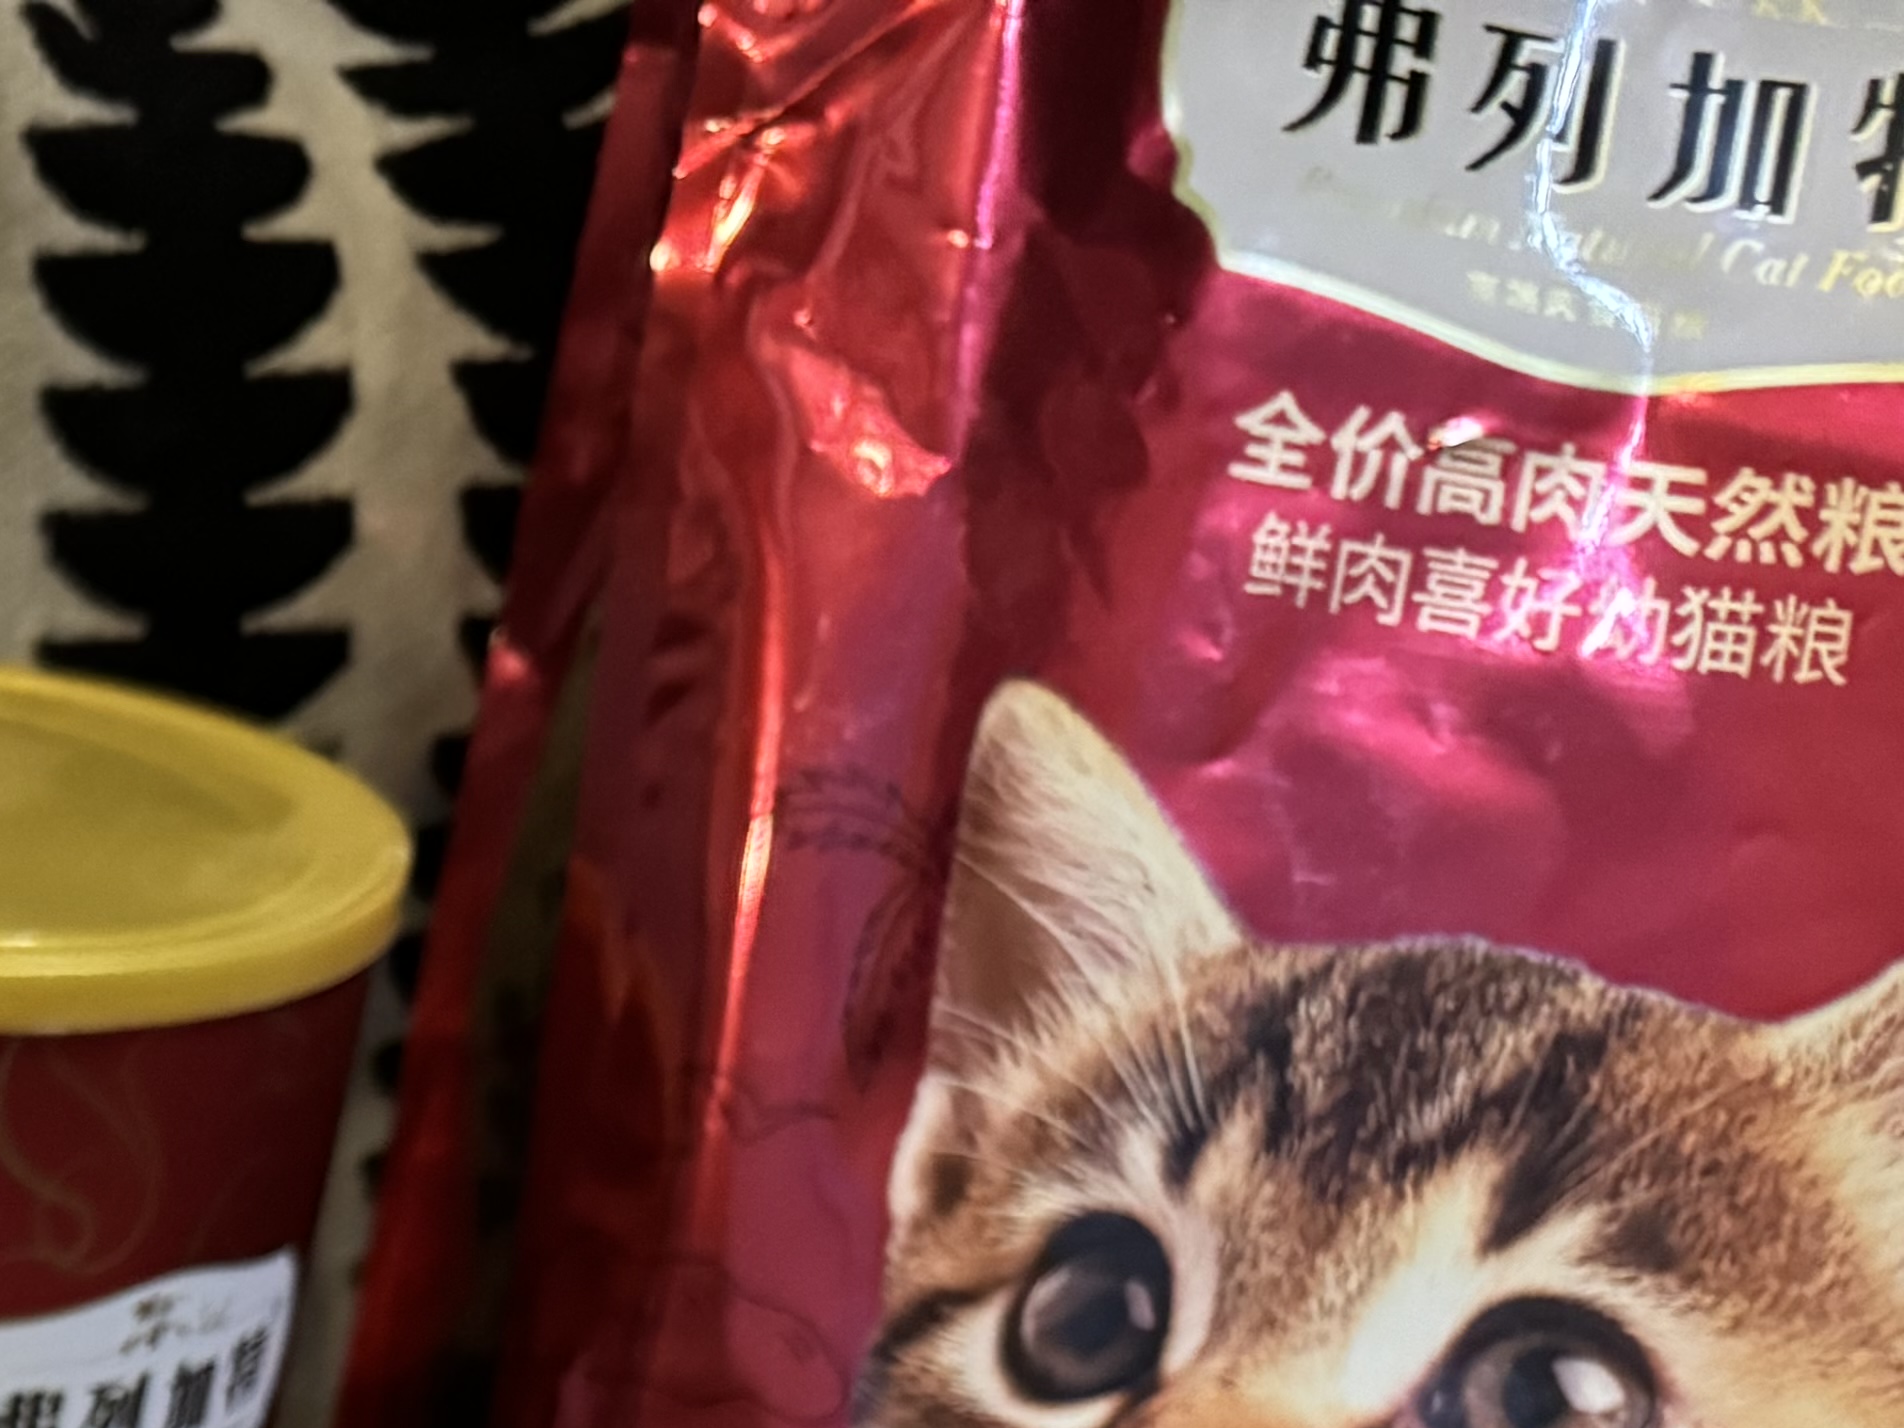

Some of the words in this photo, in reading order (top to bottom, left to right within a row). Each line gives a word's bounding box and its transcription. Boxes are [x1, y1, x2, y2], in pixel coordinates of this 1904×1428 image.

[1228, 390, 1904, 577] 全价高肉天然粮
[1244, 511, 1854, 687] 鲜肉喜好幼猫粮
